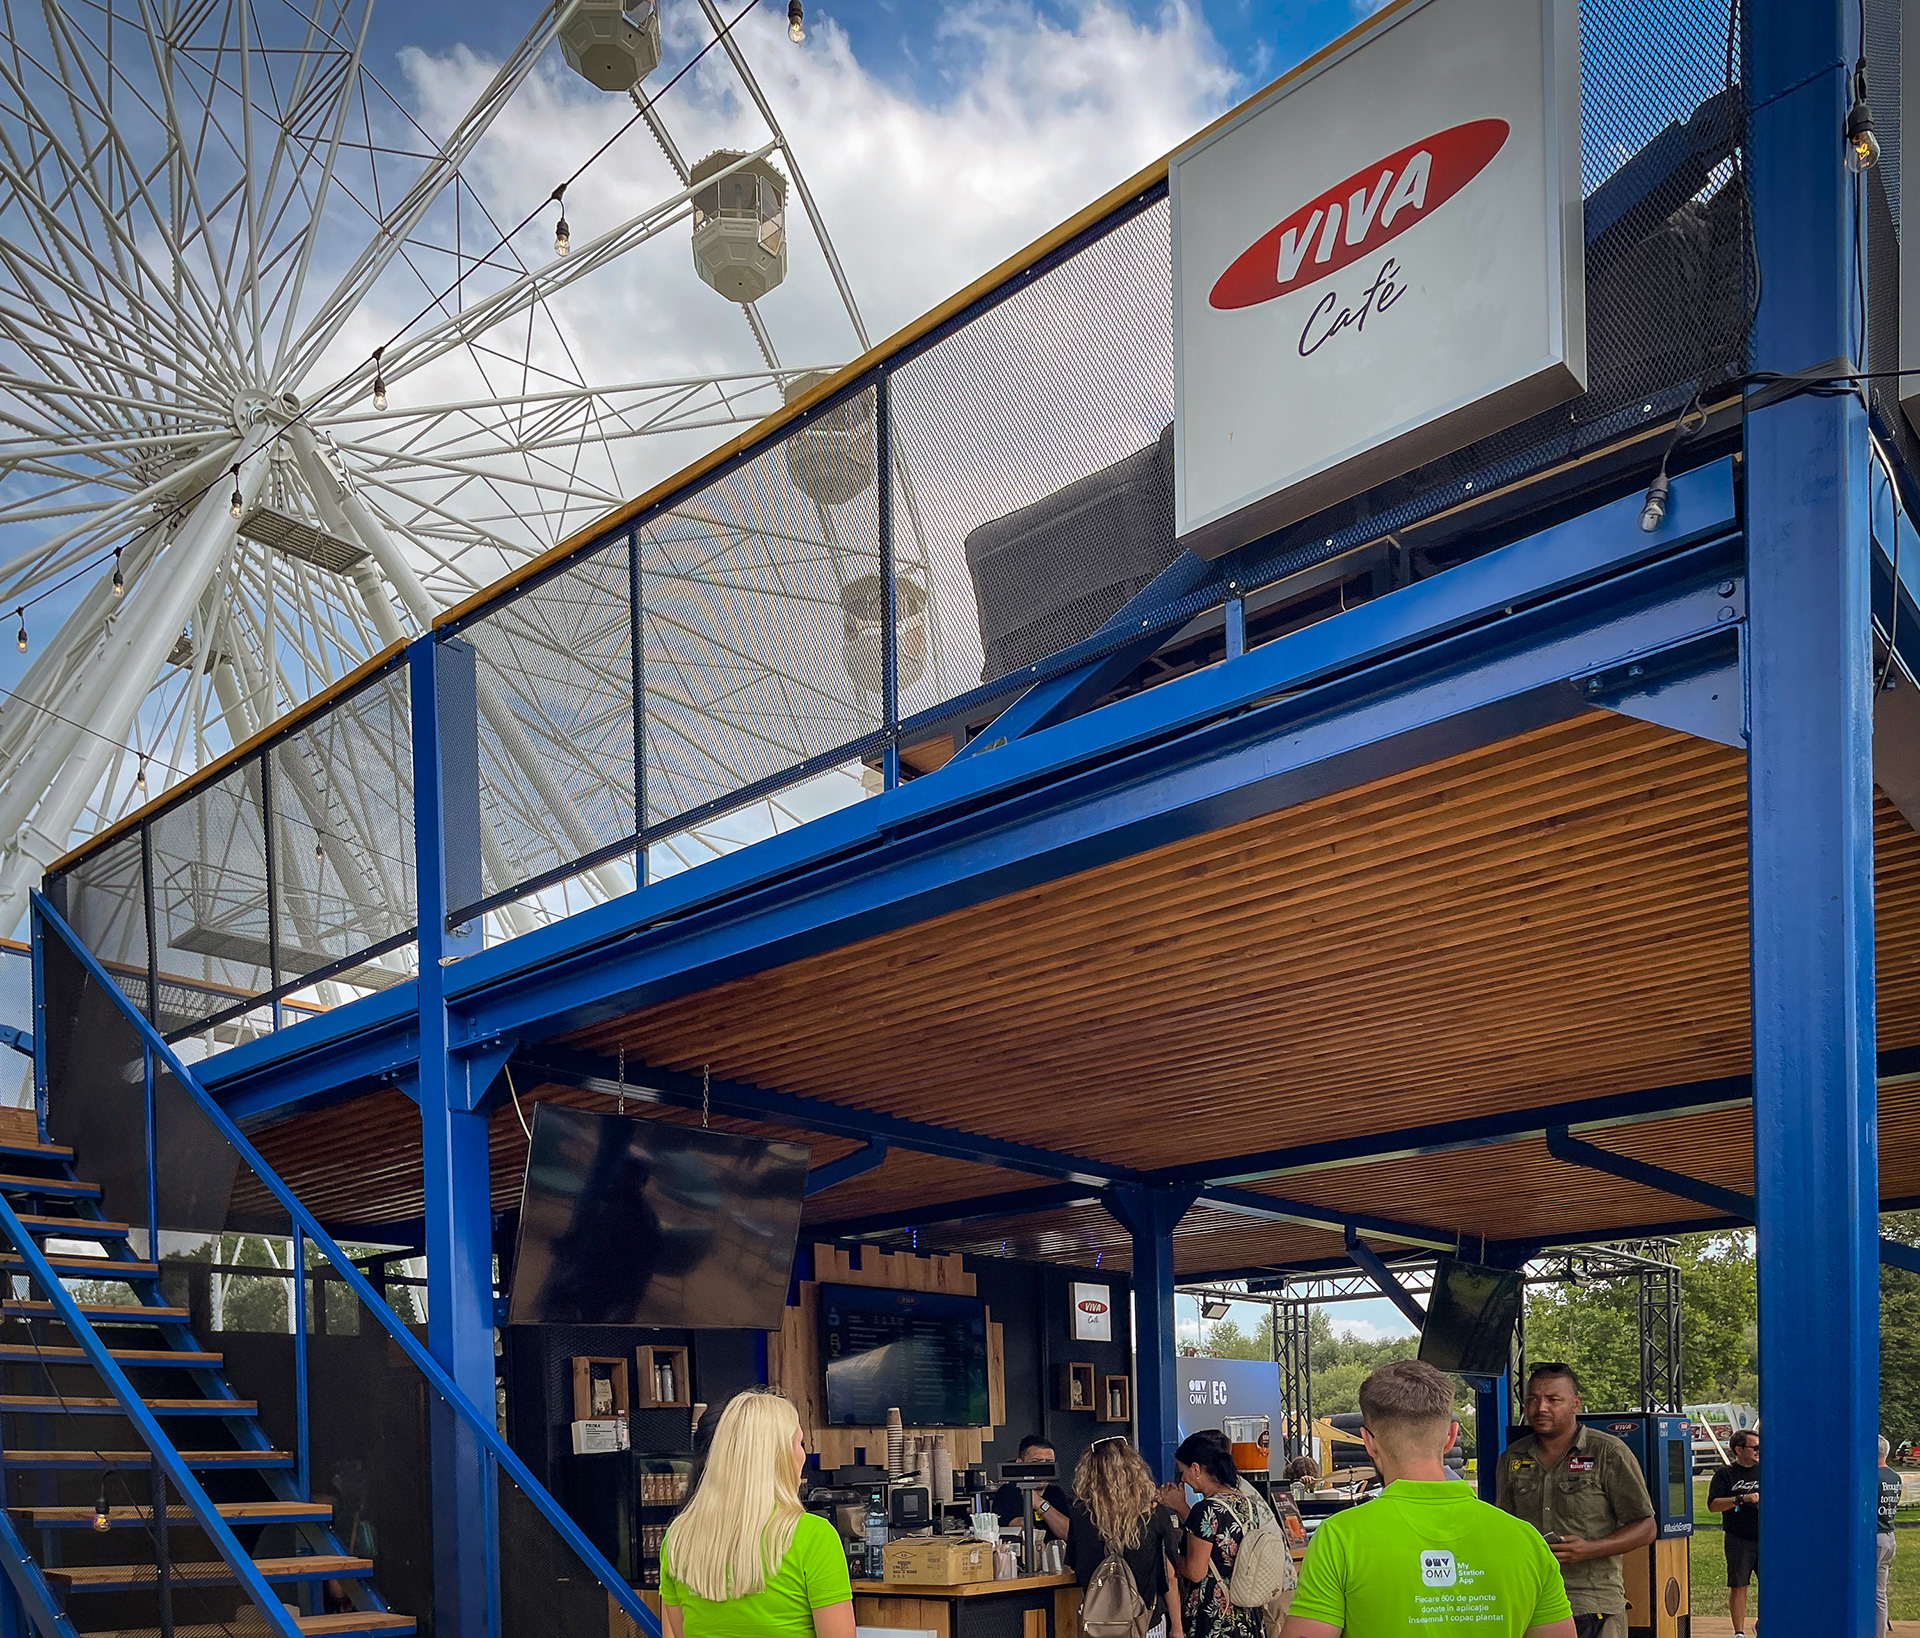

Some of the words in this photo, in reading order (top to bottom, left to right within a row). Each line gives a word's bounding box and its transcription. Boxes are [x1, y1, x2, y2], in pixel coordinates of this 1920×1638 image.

[1277, 150, 1433, 283] VIVA
[1298, 257, 1409, 358] Café
[1085, 1302, 1102, 1312] VIVA
[1189, 1393, 1207, 1405] OMV
[1212, 1380, 1228, 1405] EC
[1457, 1562, 1470, 1570] My
[1425, 1569, 1451, 1578] OMV
[1414, 1595, 1440, 1603] Fiecare
[1456, 1594, 1467, 1602] de
[1469, 1594, 1497, 1603] puncte
[1421, 1605, 1446, 1613] donate
[1450, 1615, 1474, 1623] copac
[1475, 1613, 1504, 1622] plantat
